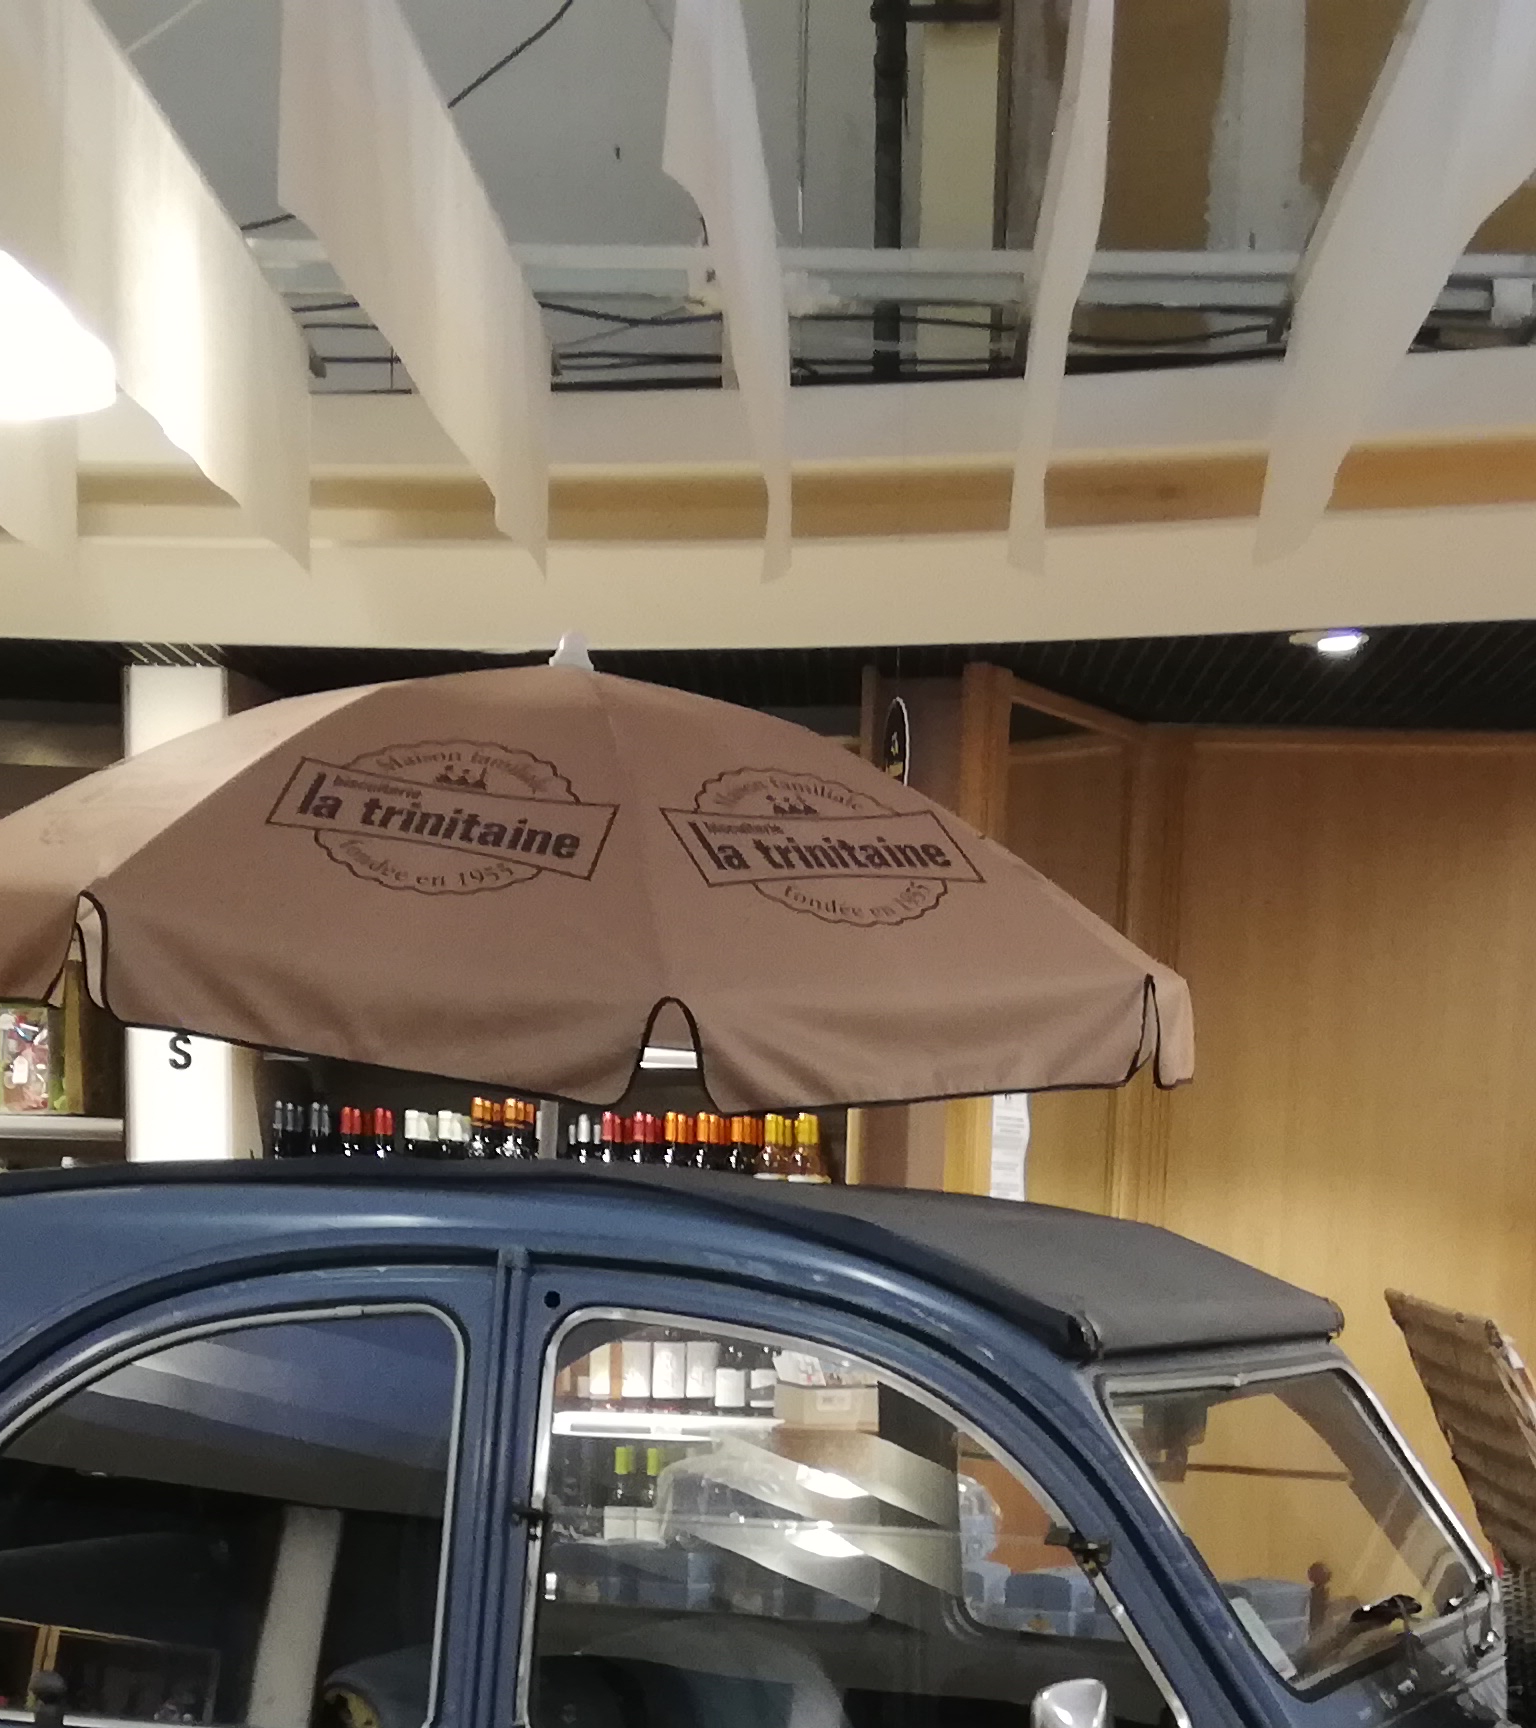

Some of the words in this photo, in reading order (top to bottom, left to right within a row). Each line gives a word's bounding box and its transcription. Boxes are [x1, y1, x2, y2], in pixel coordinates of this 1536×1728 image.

[295, 771, 343, 820] la
[359, 798, 581, 860] trinitaine
[687, 820, 751, 871] la
[752, 836, 952, 871] trinitaine
[415, 873, 446, 888] en
